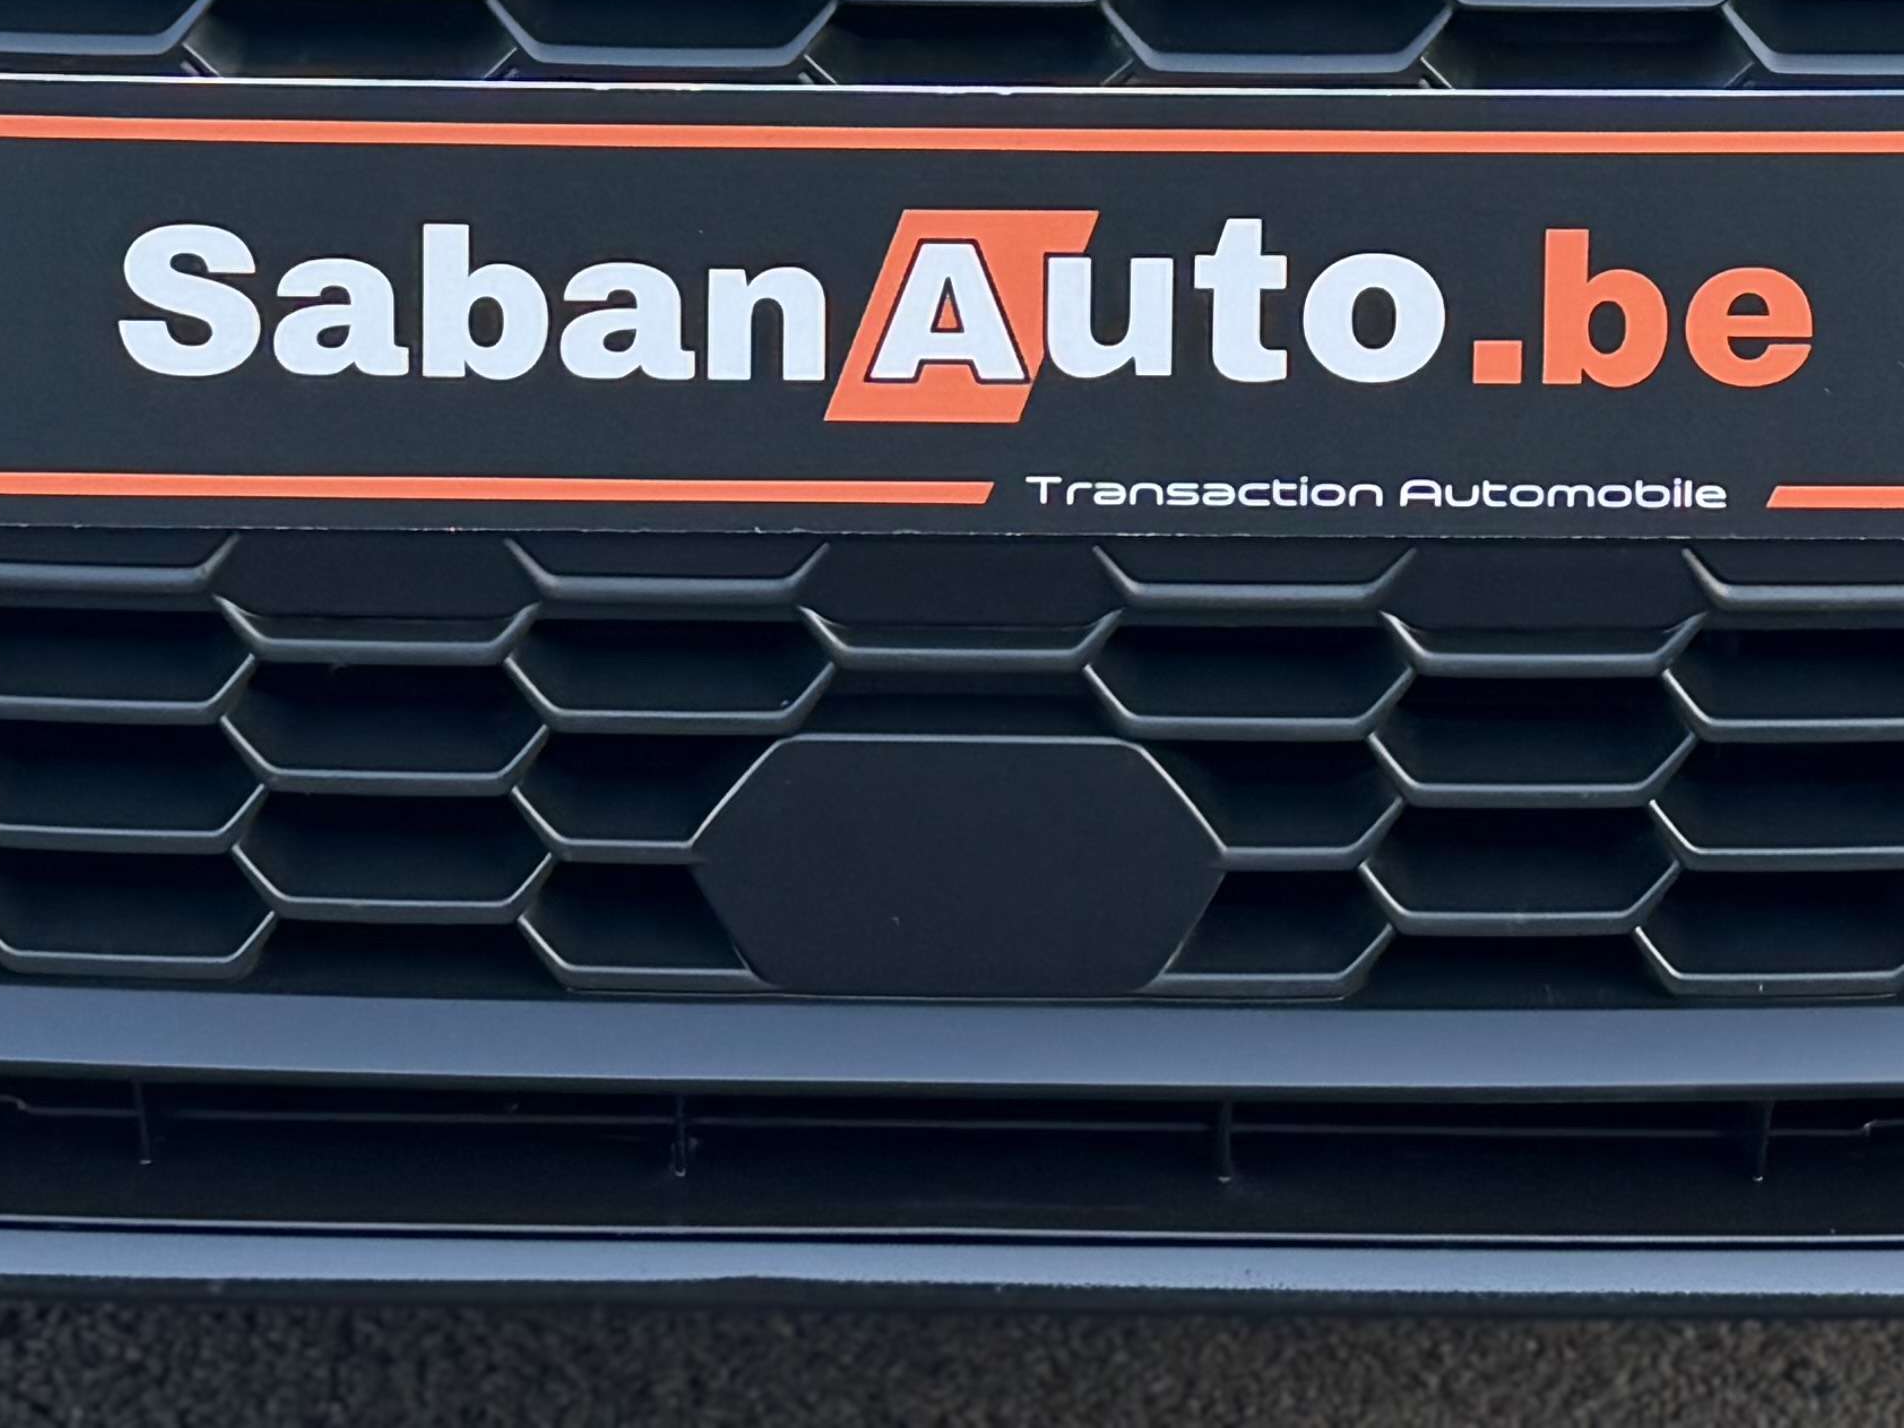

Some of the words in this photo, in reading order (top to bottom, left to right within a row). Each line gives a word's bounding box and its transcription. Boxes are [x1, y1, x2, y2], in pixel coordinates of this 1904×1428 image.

[118, 218, 1814, 388] SabanAuto.be
[1025, 475, 1384, 507] Transaction
[1400, 478, 1728, 509] Automobile
